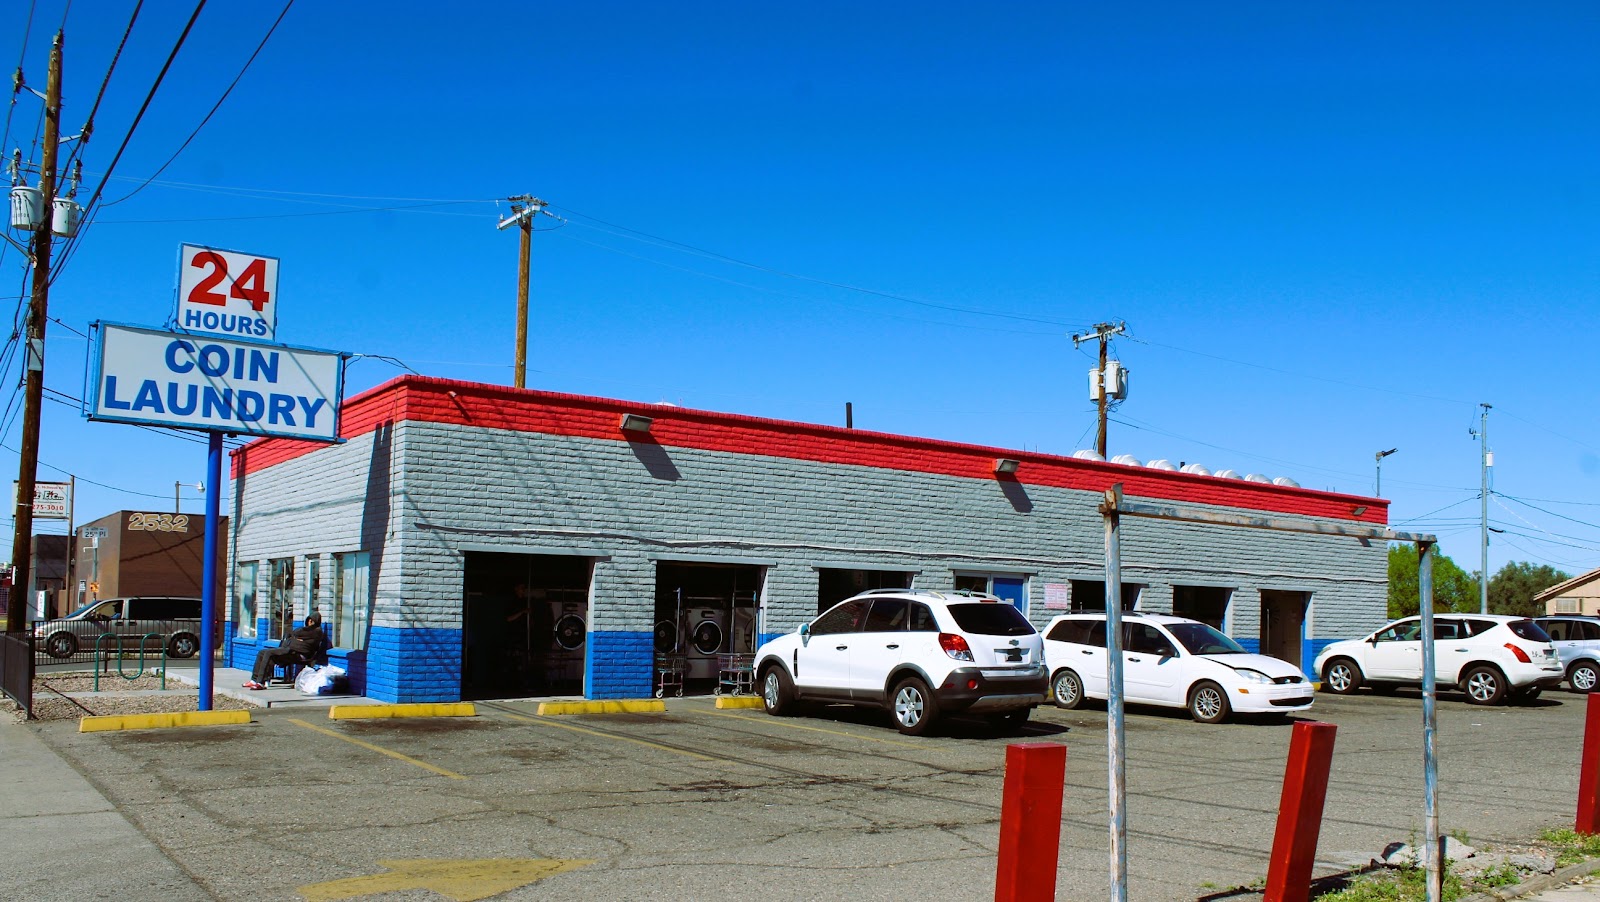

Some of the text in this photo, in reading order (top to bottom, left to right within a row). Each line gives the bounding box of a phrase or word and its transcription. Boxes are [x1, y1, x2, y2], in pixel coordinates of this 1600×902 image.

[188, 251, 269, 311] 24
[185, 309, 267, 336] HOURS
[165, 340, 279, 383] COIN
[104, 376, 327, 428] LAUNDRY
[128, 513, 188, 532] 2532
